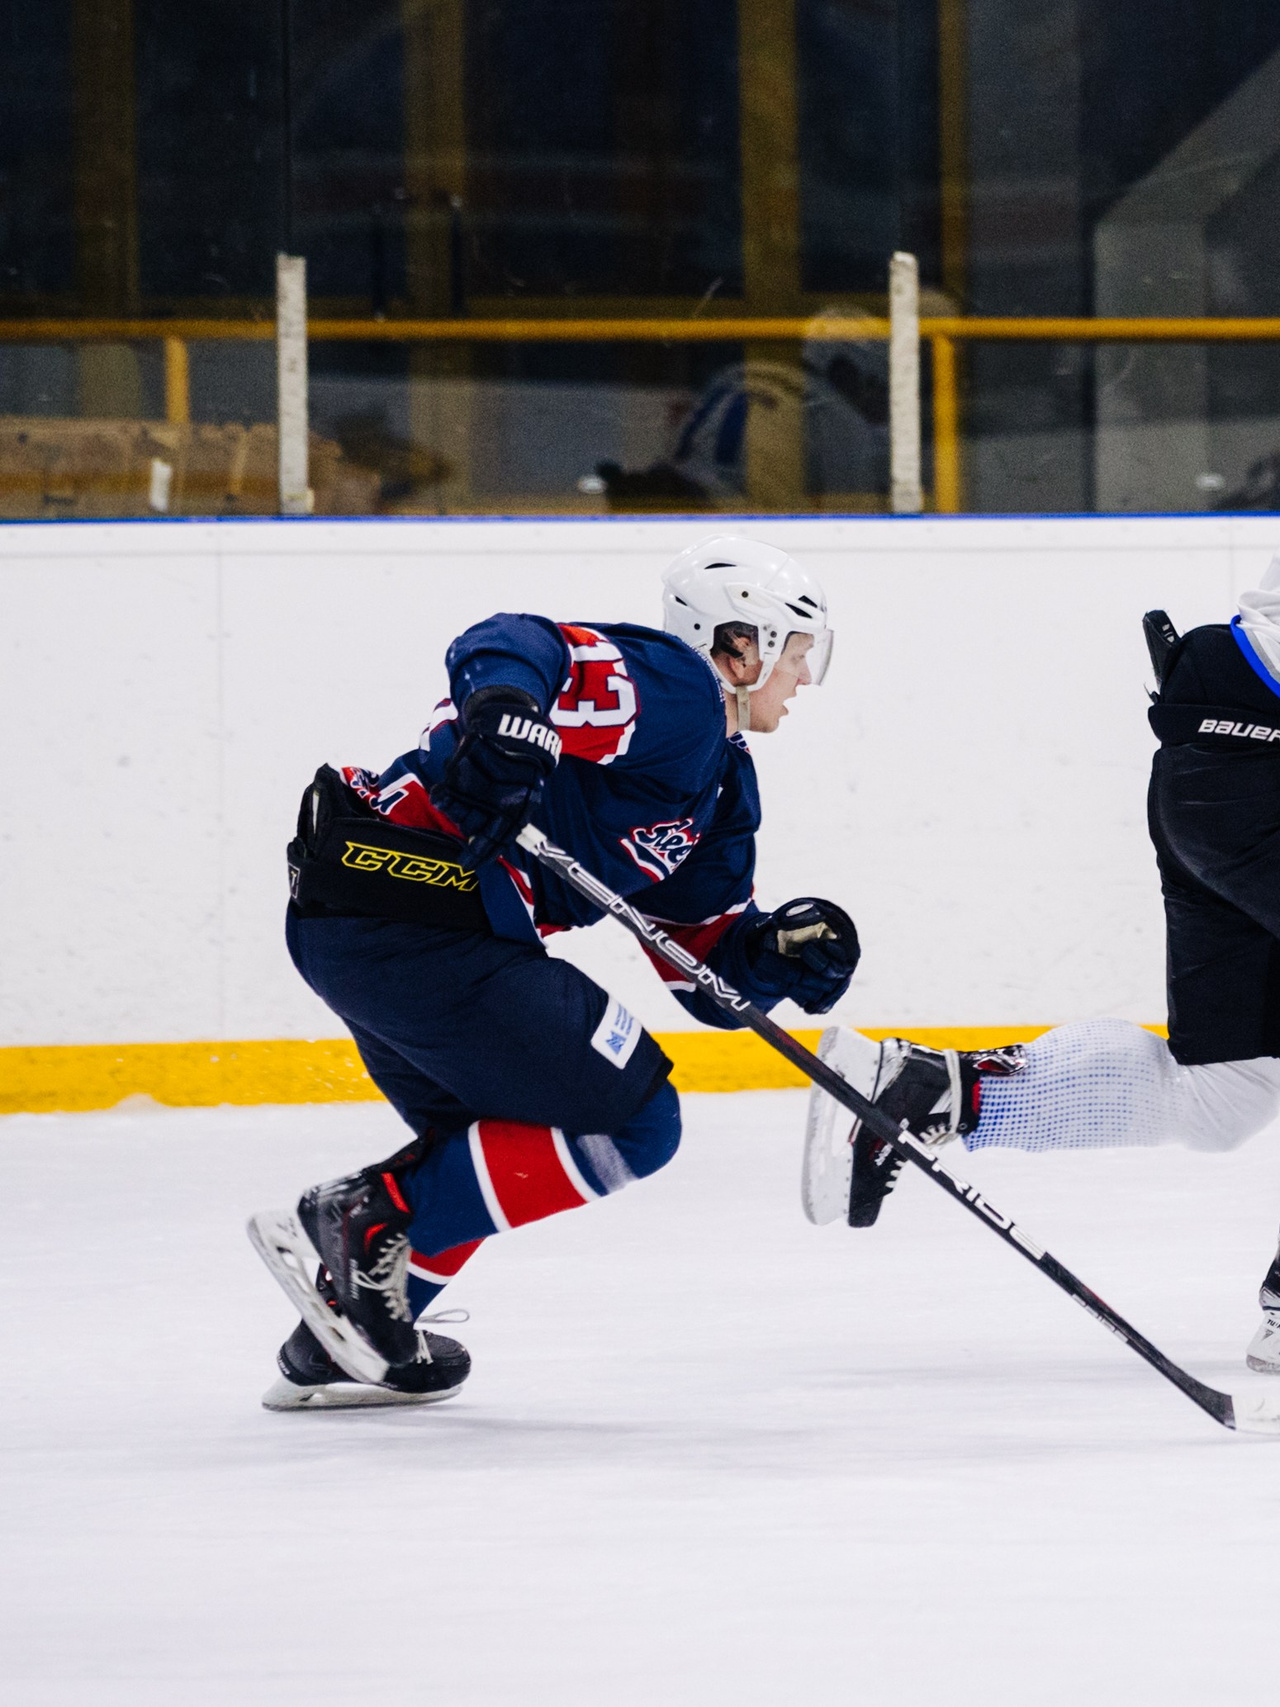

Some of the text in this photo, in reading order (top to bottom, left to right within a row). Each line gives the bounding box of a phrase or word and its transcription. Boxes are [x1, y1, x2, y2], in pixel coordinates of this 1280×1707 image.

[497, 713, 563, 768] WAR
[341, 841, 479, 892] CCM
[536, 841, 751, 1011] VENOM
